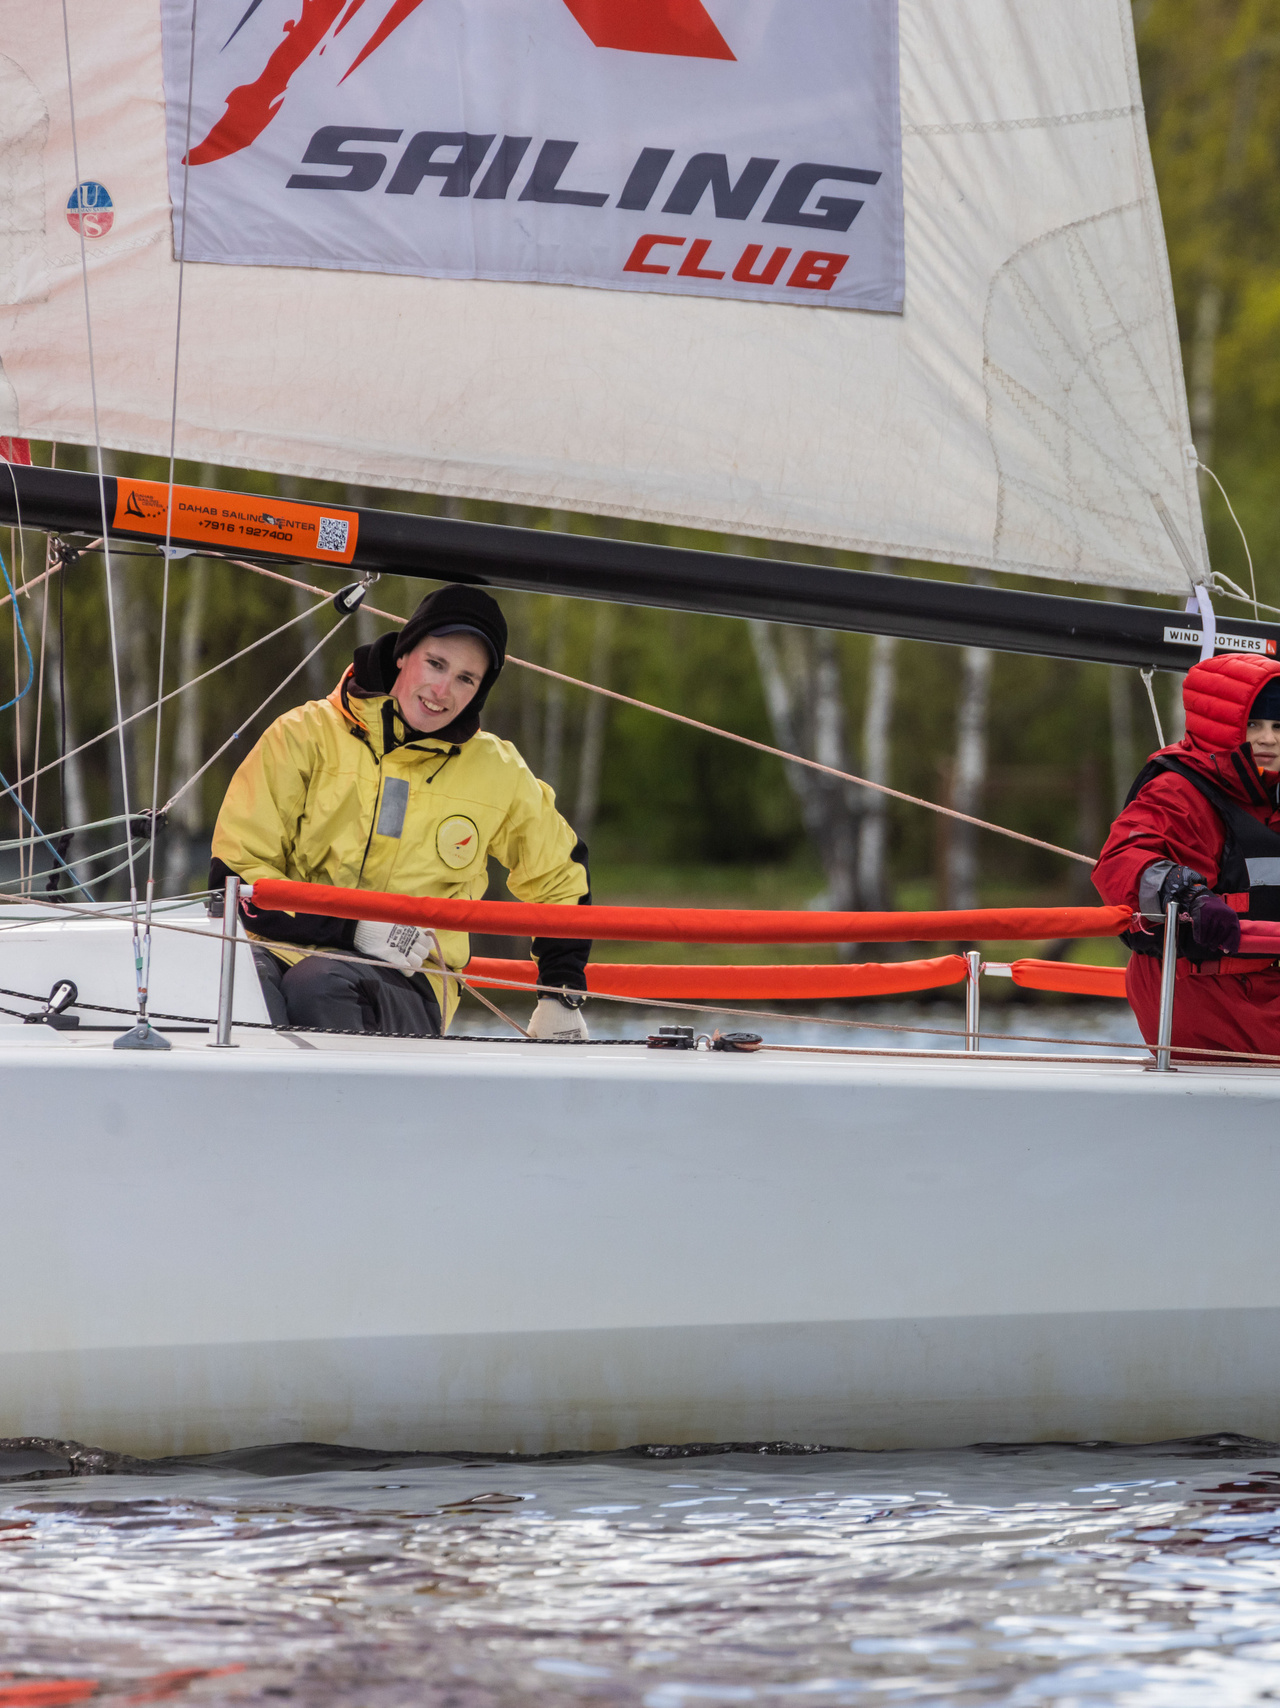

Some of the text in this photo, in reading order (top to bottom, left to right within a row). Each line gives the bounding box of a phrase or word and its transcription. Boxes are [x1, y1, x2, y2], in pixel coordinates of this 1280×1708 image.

[286, 125, 882, 232] SAILING
[80, 185, 99, 207] U
[84, 213, 102, 237] S
[623, 234, 850, 290] CLUB
[178, 503, 218, 515] DAHAB
[273, 517, 316, 531] ENTER
[199, 520, 293, 542] +7916 1927400
[1169, 630, 1199, 642] WIND
